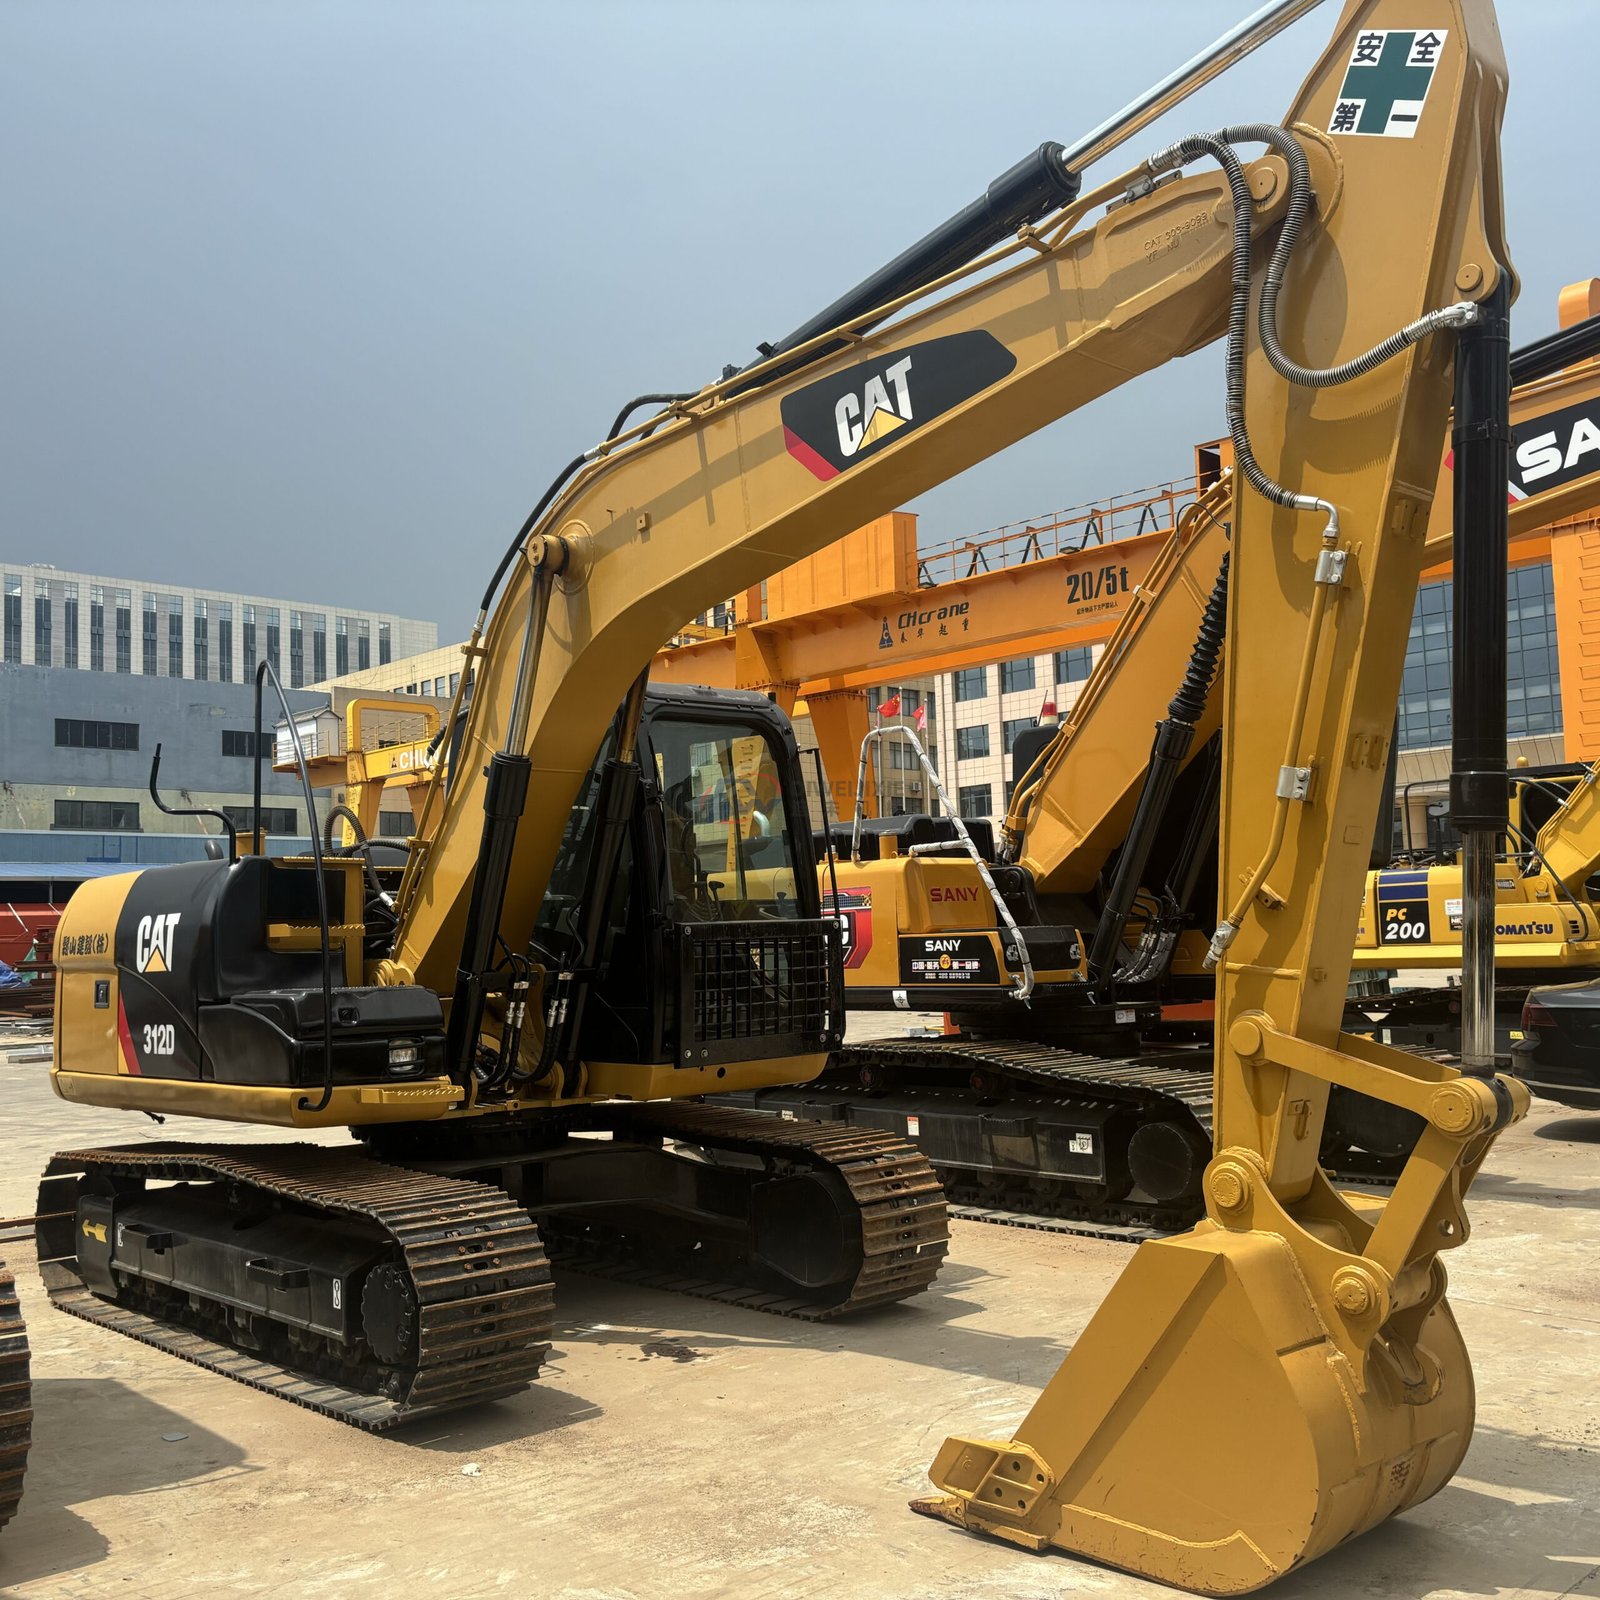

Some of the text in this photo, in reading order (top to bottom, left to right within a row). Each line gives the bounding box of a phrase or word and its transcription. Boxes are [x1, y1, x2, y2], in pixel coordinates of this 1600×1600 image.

[1352, 32, 1441, 63] 安全
[1330, 102, 1418, 132] 第一
[1144, 235, 1162, 251] CAT
[835, 355, 913, 457] CAT
[1066, 565, 1130, 604] 20/5t
[930, 887, 979, 902] SANY
[1386, 908, 1407, 921] PC
[1385, 922, 1425, 939] 200
[1495, 921, 1554, 936] OMATSU
[136, 913, 181, 974] CAT
[925, 939, 961, 952] SANY
[143, 1024, 175, 1055] 312D
